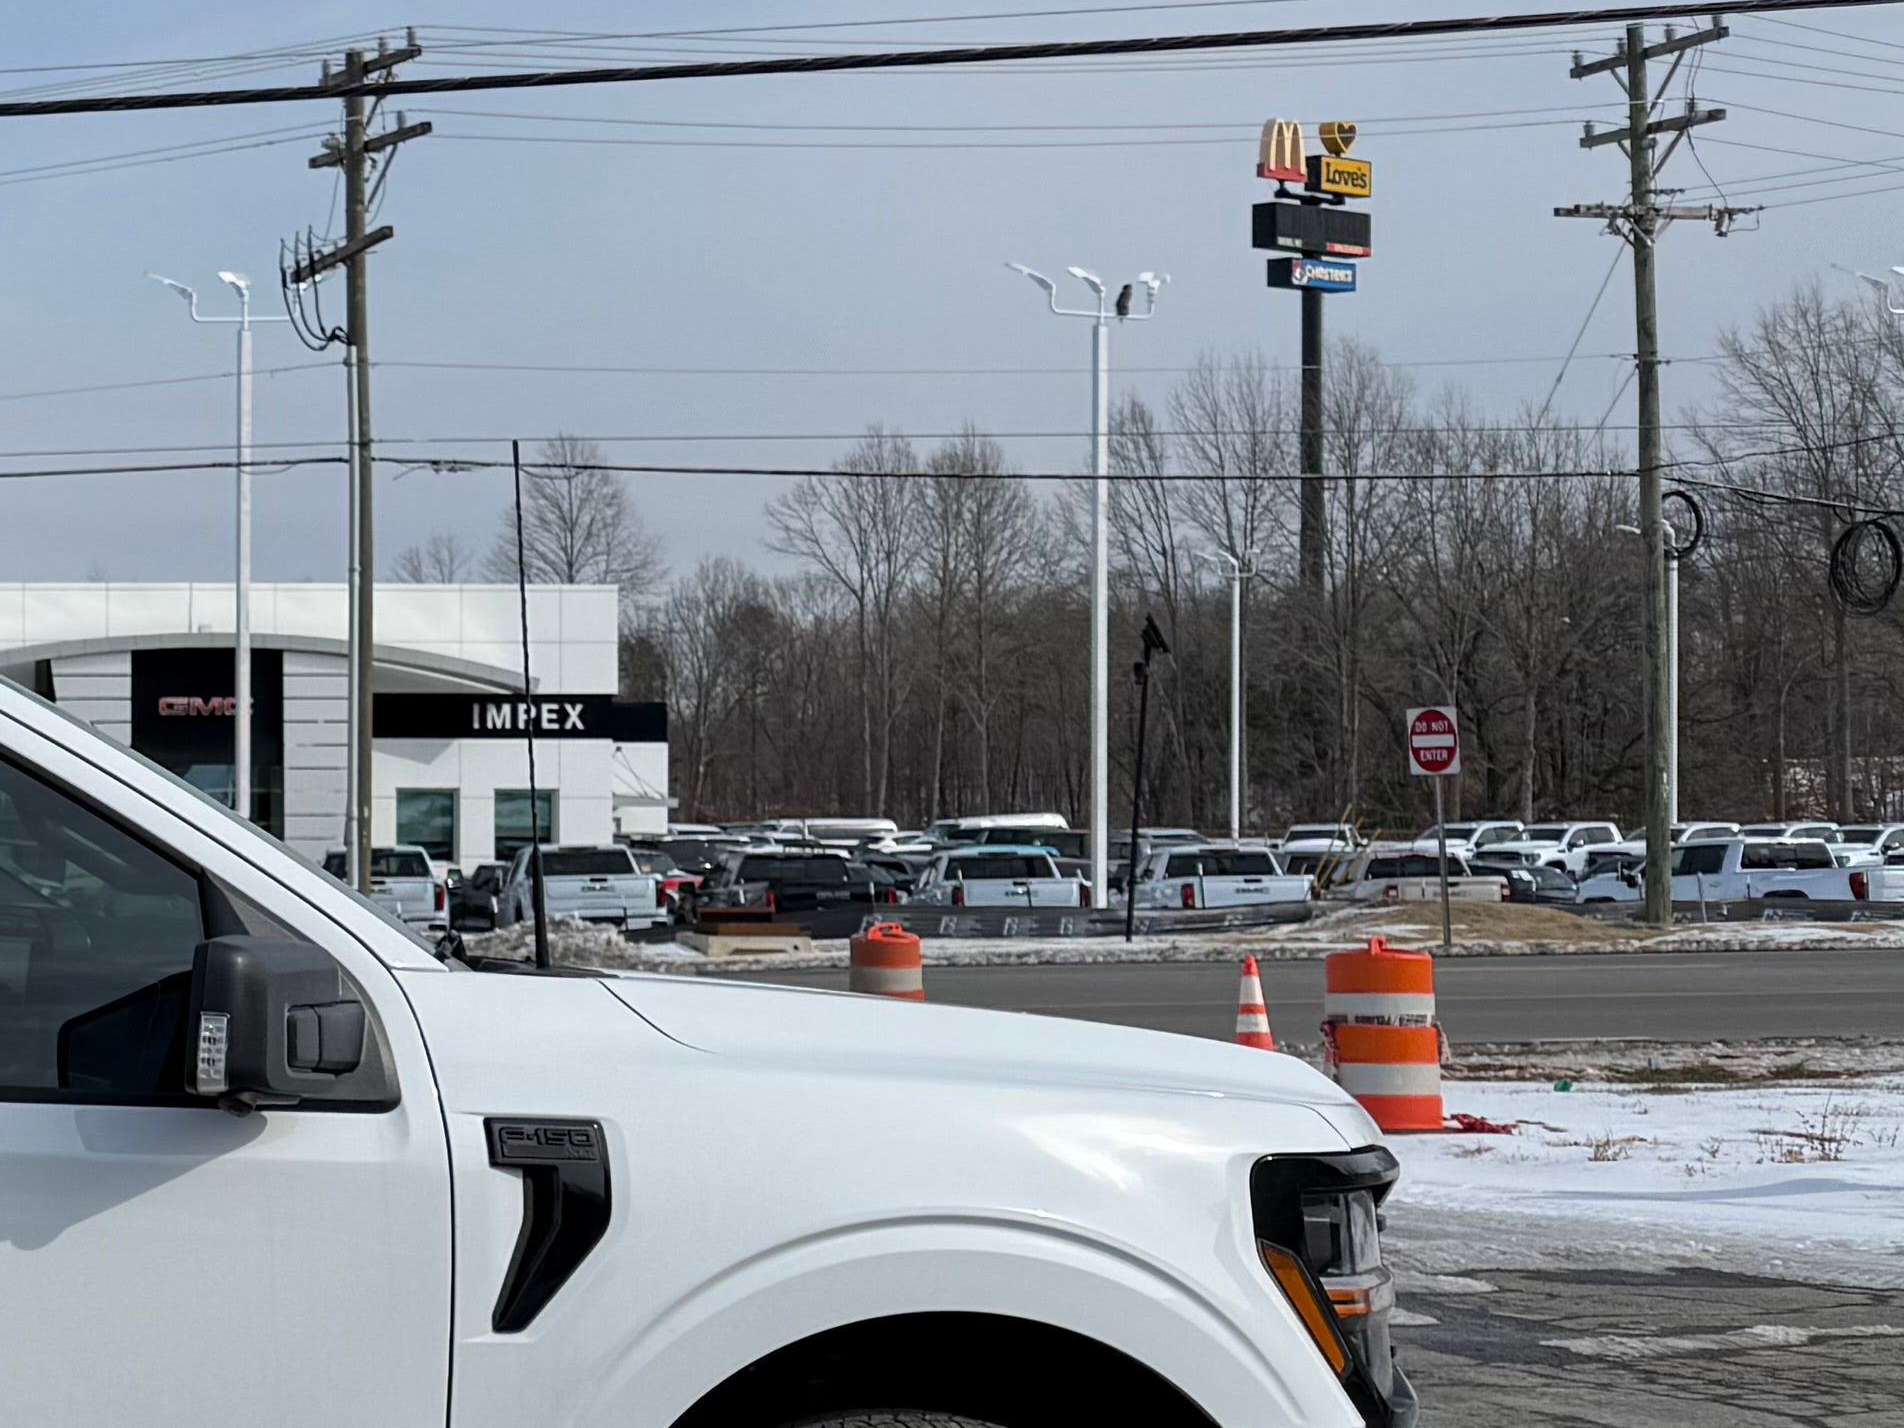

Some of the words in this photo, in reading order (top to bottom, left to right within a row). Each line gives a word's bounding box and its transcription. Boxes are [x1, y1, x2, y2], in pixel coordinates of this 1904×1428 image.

[1325, 161, 1368, 189] Love's
[472, 702, 585, 730] IMPEX
[1414, 720, 1428, 733] DO
[1431, 719, 1449, 732] NOT
[1420, 748, 1449, 762] ENTER
[498, 1126, 595, 1147] F-150
